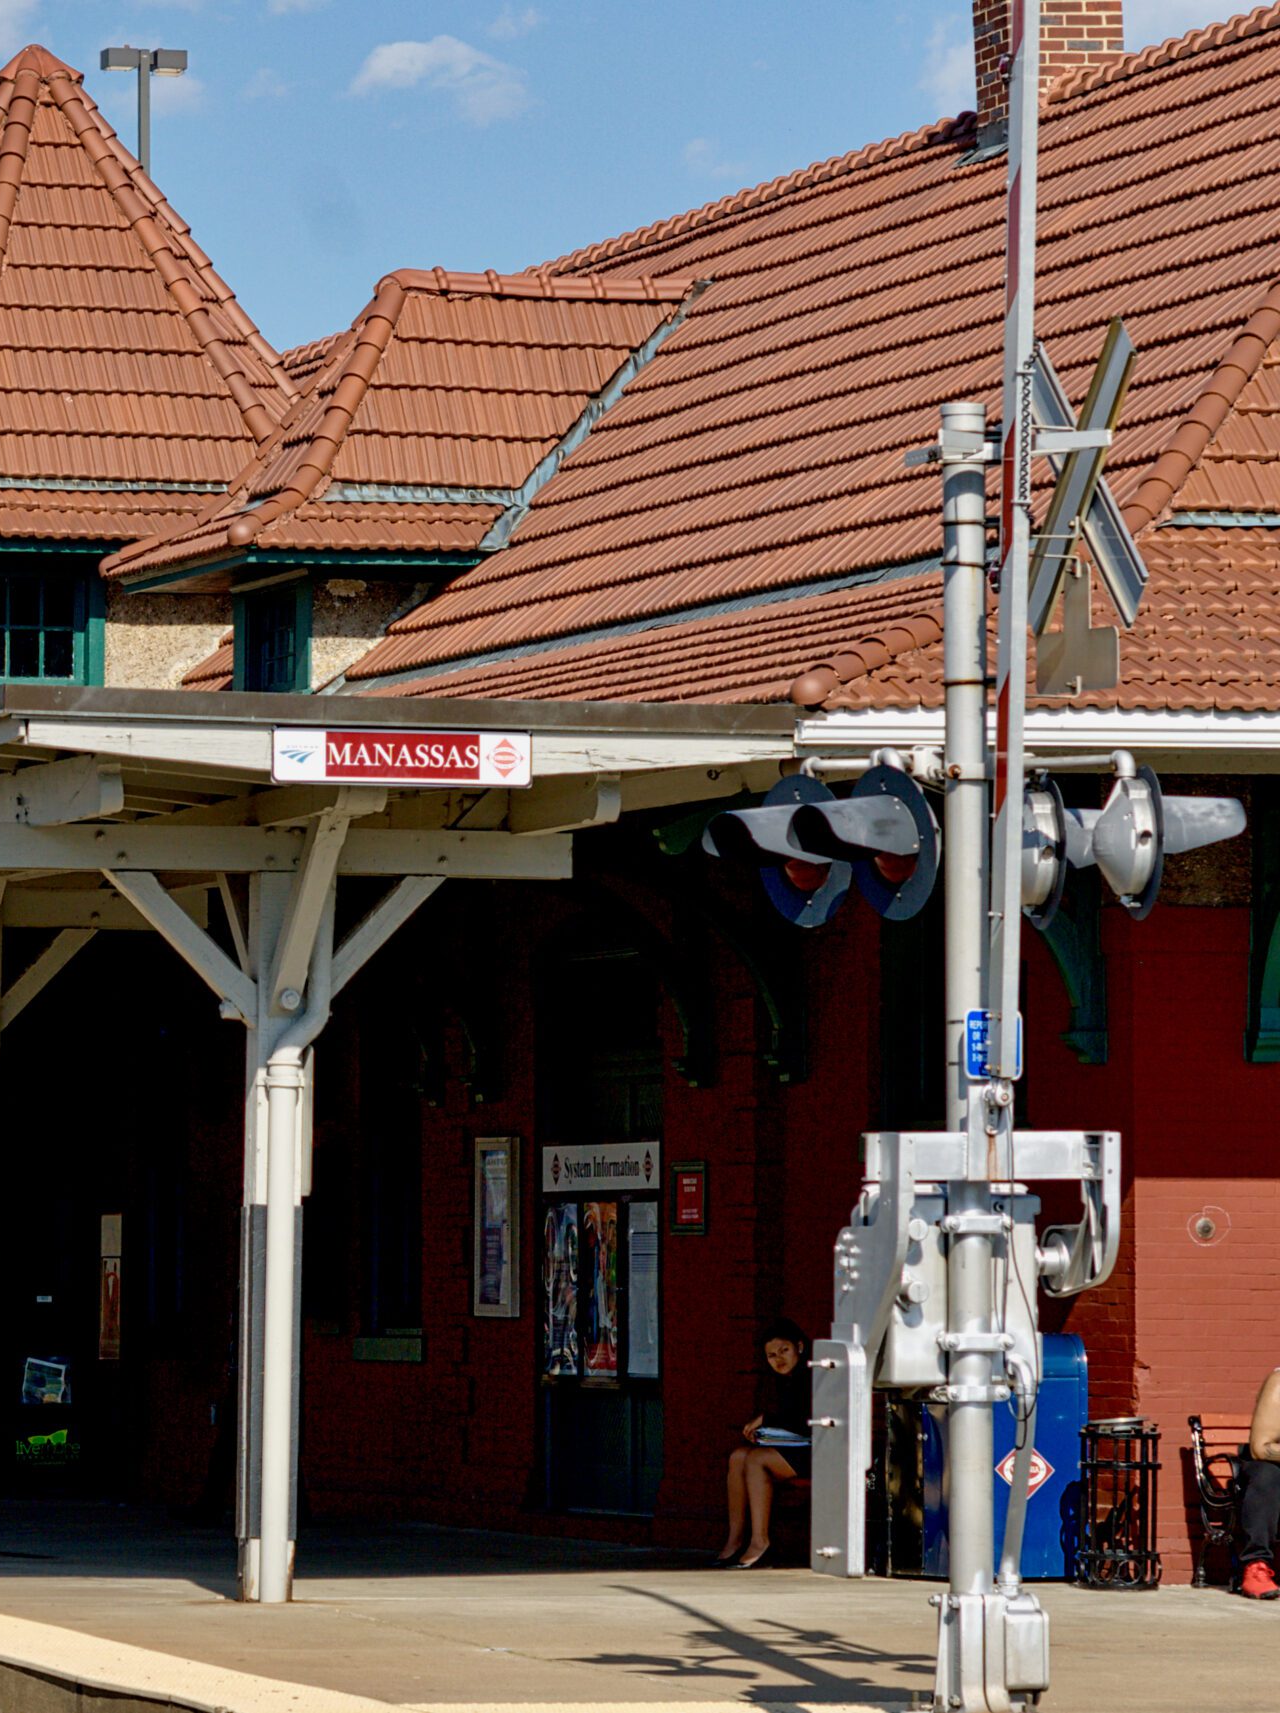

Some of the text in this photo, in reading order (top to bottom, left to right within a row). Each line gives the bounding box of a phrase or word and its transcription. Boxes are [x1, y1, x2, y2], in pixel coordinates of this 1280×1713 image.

[328, 742, 479, 769] MANASSAS
[564, 1155, 640, 1184] System Information
